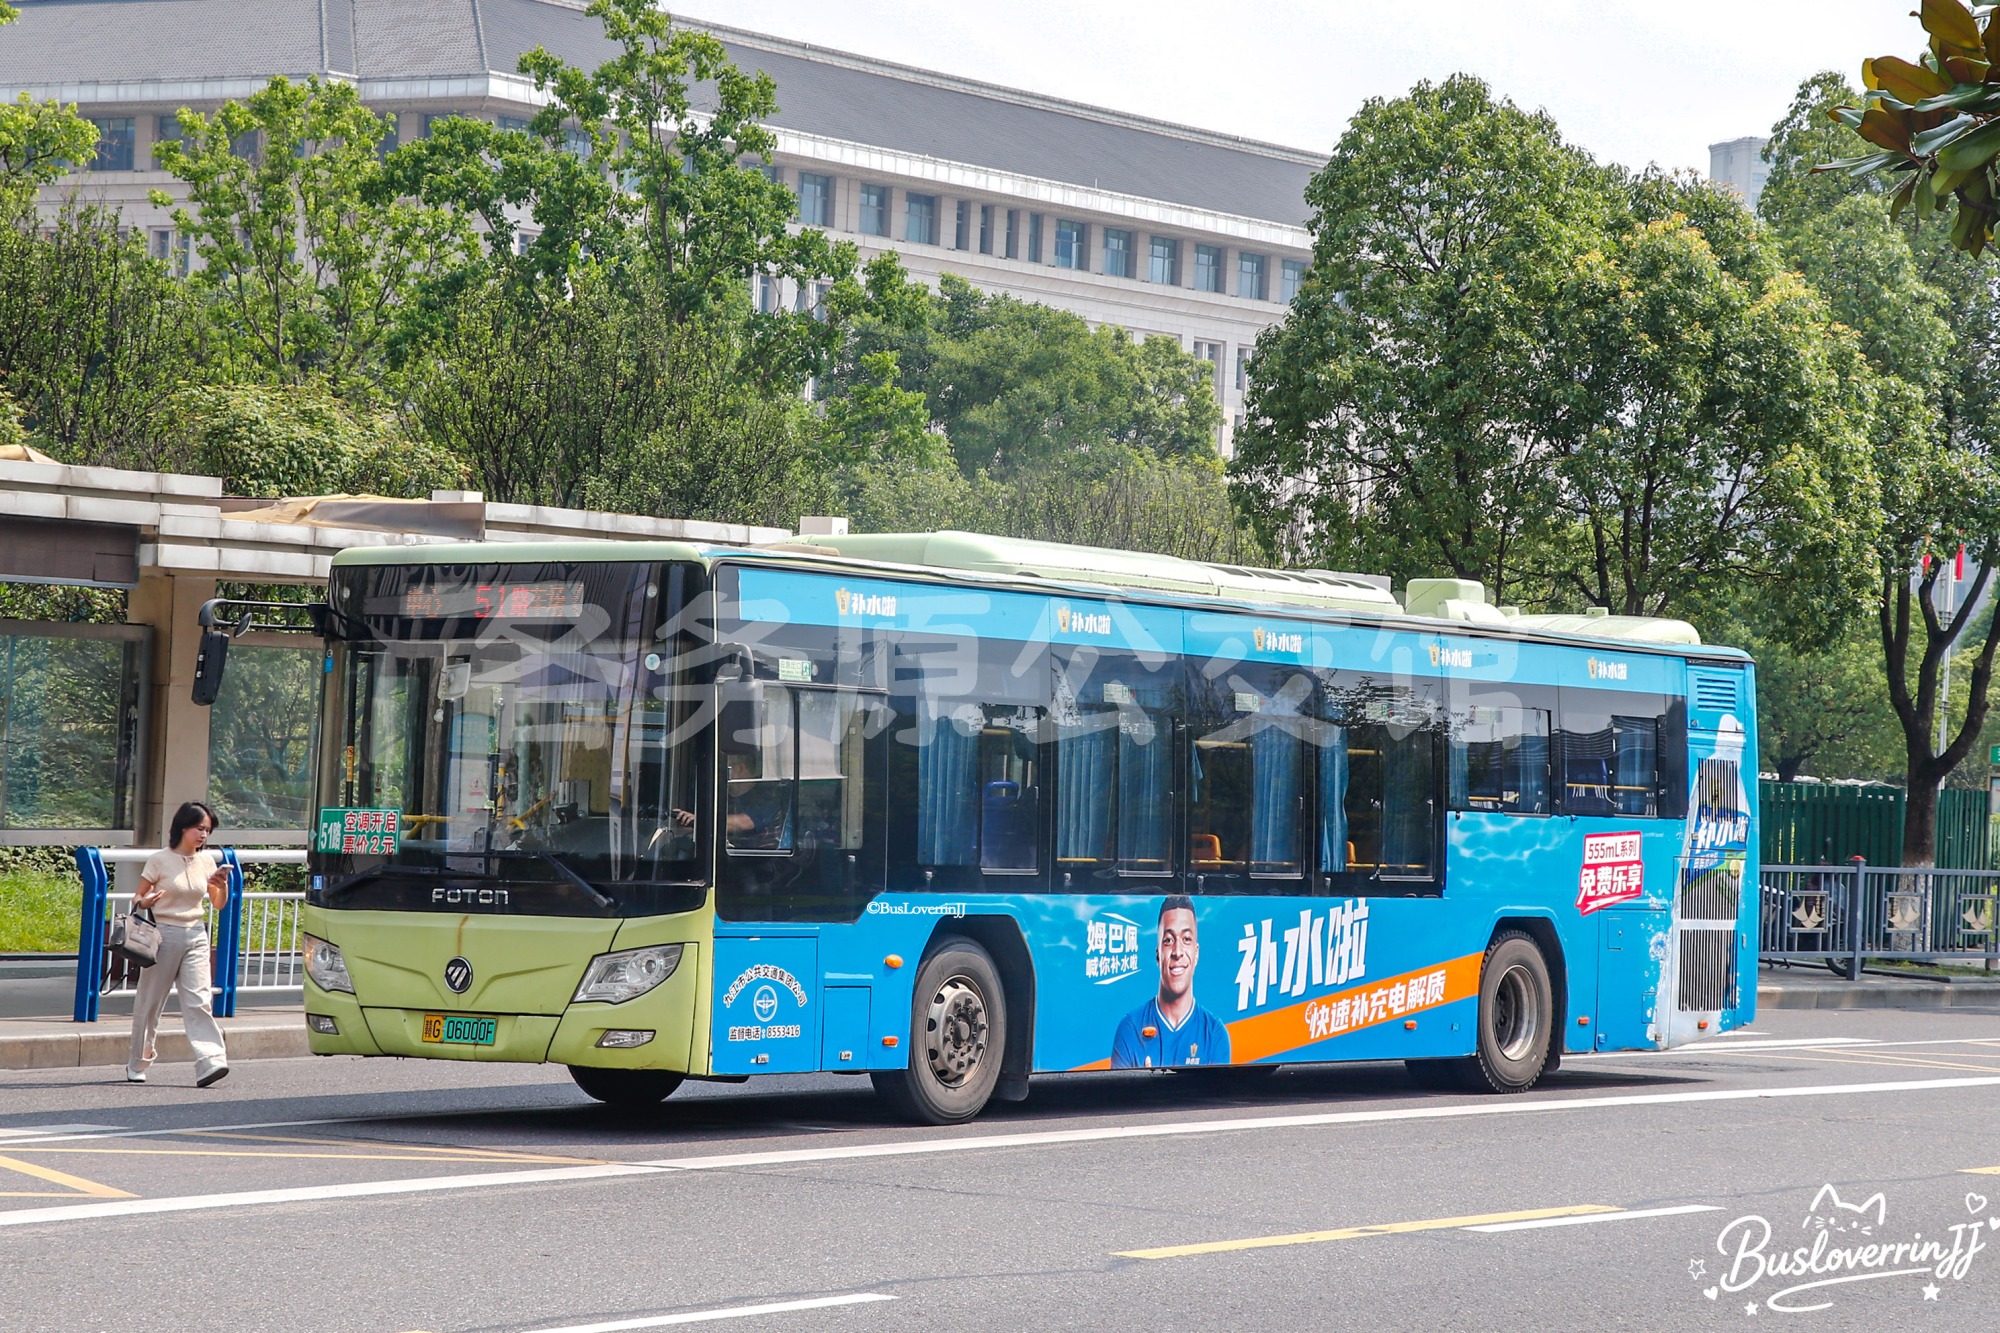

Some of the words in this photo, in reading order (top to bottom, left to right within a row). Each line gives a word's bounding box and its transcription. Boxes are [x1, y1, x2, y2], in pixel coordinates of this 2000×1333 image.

[852, 593, 896, 617] 补水啦
[1071, 612, 1111, 635] 补水啦
[1266, 632, 1302, 653] 补水啦
[1440, 648, 1472, 668] 补水啦
[1598, 661, 1628, 680] 补水啦
[344, 811, 397, 833] 空调开启
[320, 822, 342, 850] 51路
[343, 835, 395, 855] 票价2元
[1588, 840, 1637, 859] 555mL系列
[1577, 864, 1642, 905] 免费乐享
[1086, 919, 1138, 955] 姆巴佩
[1085, 954, 1138, 978] 喊你补水啦
[1234, 897, 1369, 1011] 补水啦
[723, 964, 807, 1008] 九江市公共交通集团公司
[1308, 969, 1446, 1040] 快速补充电解质
